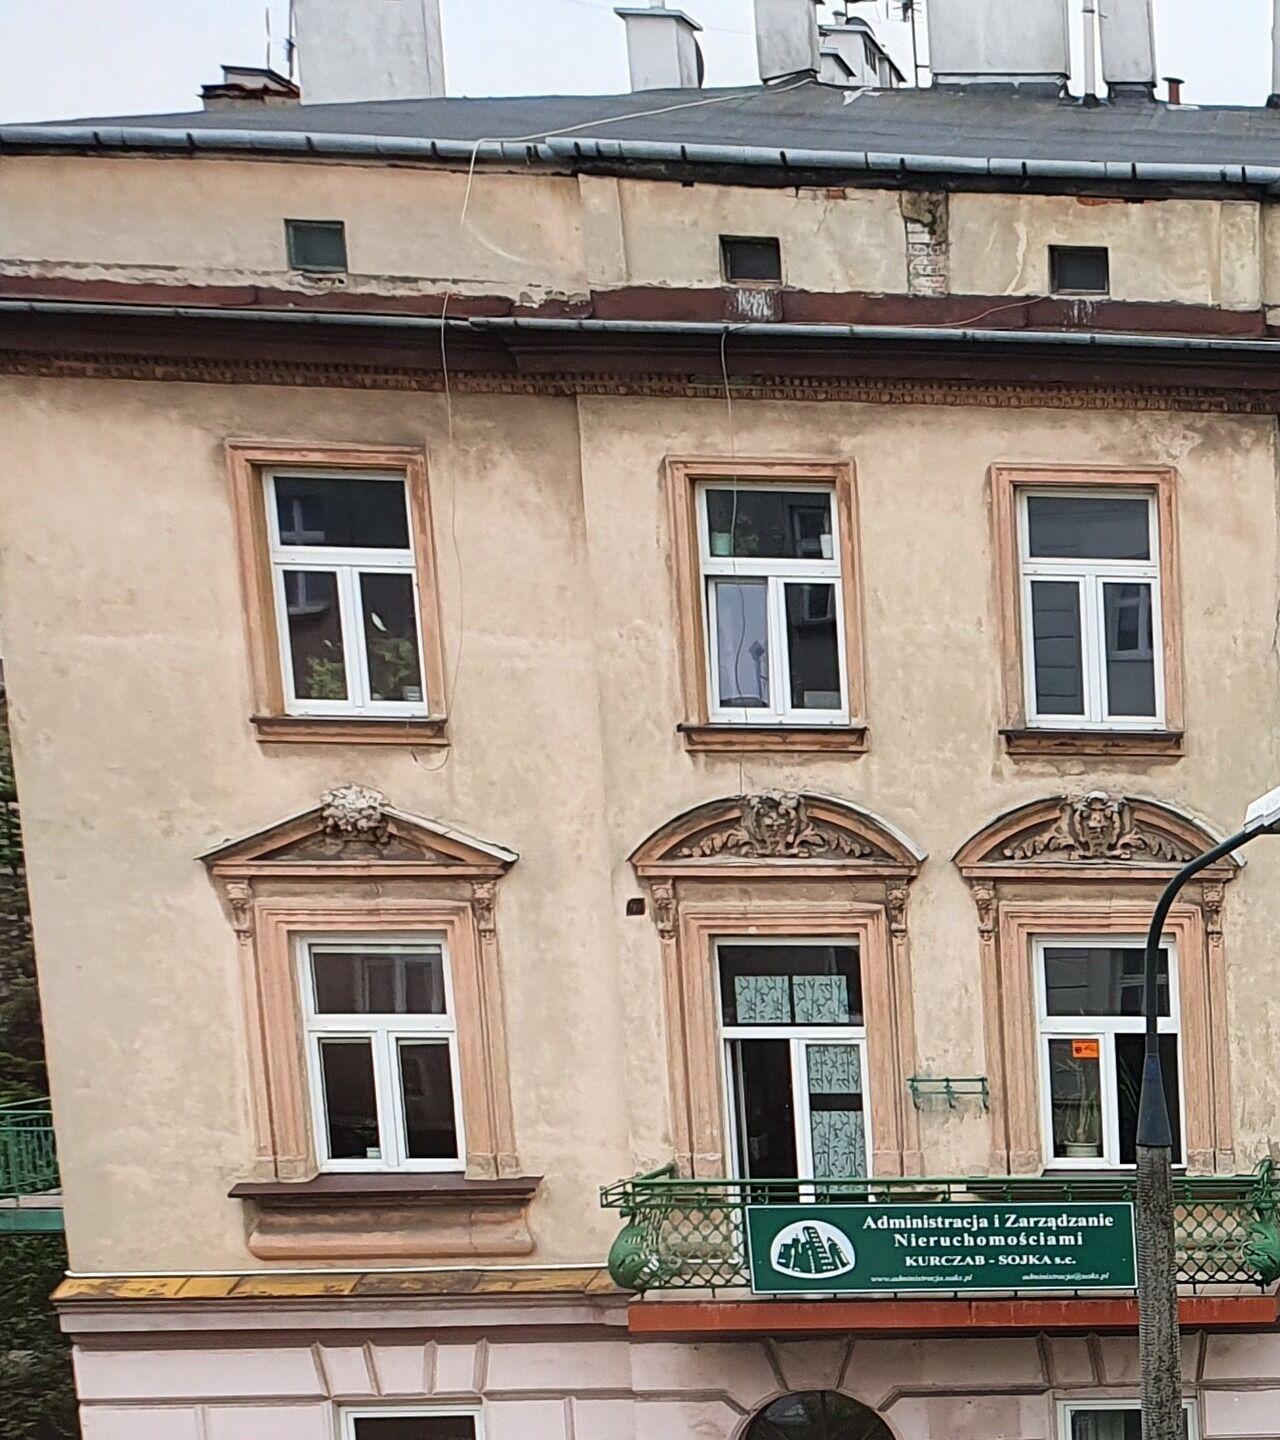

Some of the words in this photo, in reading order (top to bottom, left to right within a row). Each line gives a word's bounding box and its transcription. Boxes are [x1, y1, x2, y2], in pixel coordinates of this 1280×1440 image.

[862, 1214, 988, 1231] Administracja
[994, 1214, 999, 1228] i
[1004, 1213, 1114, 1231] Zarządzanie
[893, 1231, 1083, 1248] Nieruchomościami
[905, 1255, 986, 1267] KURCZAB
[998, 1254, 1051, 1266] SOJKA
[1054, 1255, 1077, 1265] s.c.
